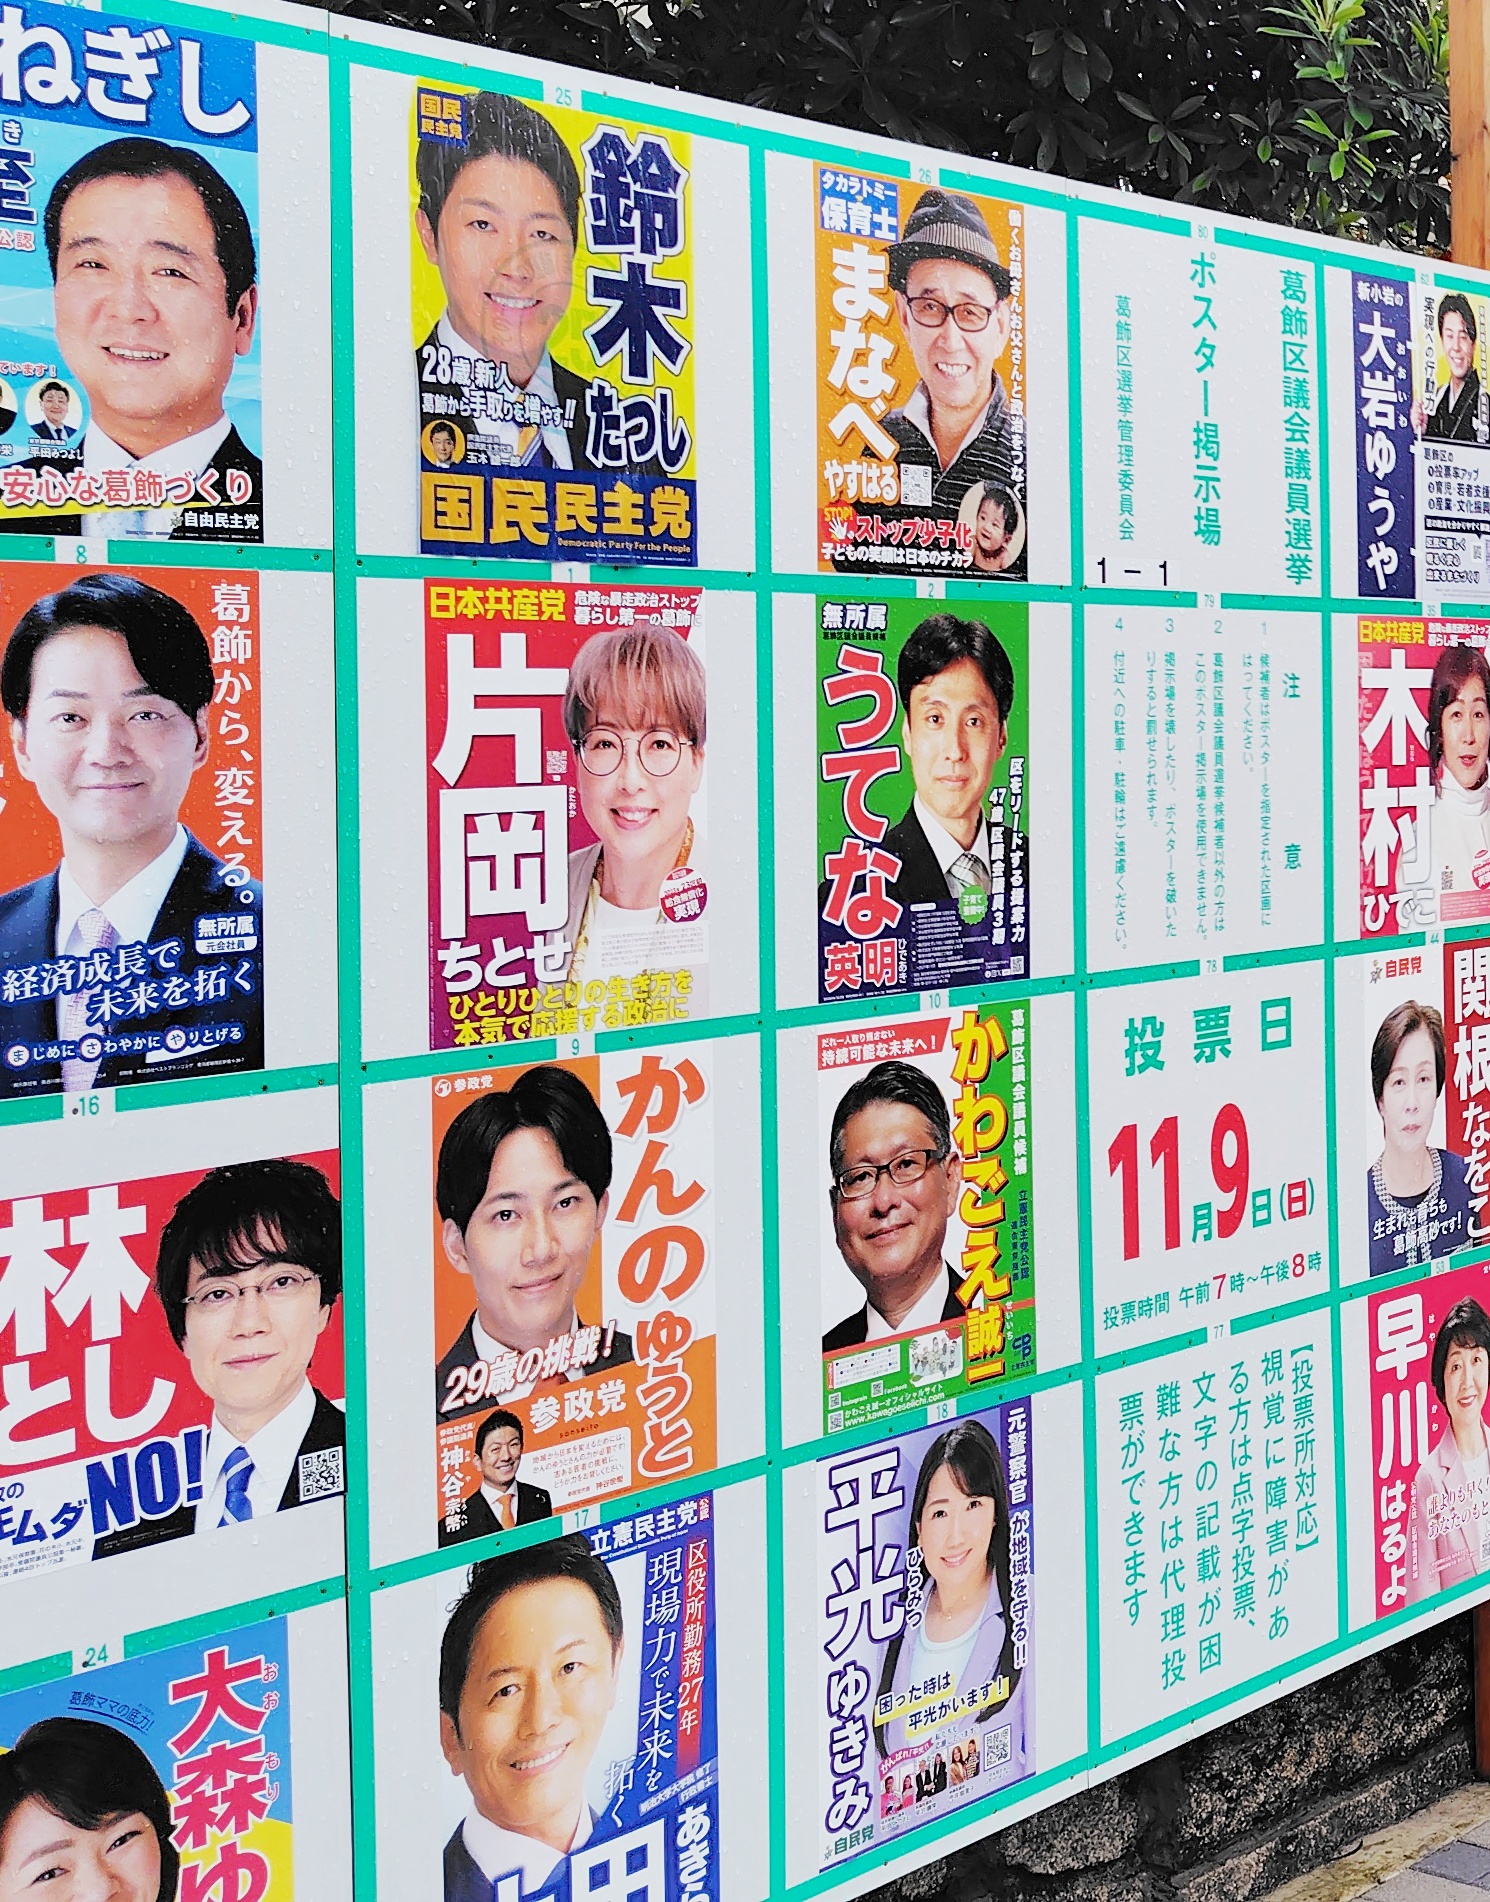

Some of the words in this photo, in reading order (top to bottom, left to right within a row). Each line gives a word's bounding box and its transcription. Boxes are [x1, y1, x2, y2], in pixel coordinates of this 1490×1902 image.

[0, 17, 252, 136] ねぎし
[555, 88, 571, 105] 25
[420, 93, 464, 121] 国民
[421, 120, 464, 141] 民主党
[822, 169, 896, 200] タカラトミー
[919, 168, 931, 183] 26
[821, 196, 898, 240] 保育士
[582, 124, 692, 386] 鈴木
[1357, 280, 1403, 308] 新小岩の
[828, 243, 898, 460] まなべ
[1115, 295, 1134, 541] 葛飾区選挙管理委員会
[1189, 251, 1221, 546] ポスター掲示場
[1280, 269, 1313, 585] 葛飾区議会議員選挙
[1359, 310, 1400, 591] 大岩ゆうや
[29, 446, 84, 460] 平田みつよし
[3, 466, 253, 507] 安心な葛飾づくり
[824, 458, 898, 503] やすはる
[183, 511, 259, 530] 自由民主党
[422, 472, 693, 545] 国民民主党
[855, 515, 973, 550] ストップ少子化
[75, 545, 87, 564] 8
[557, 537, 607, 551] Democratic
[608, 540, 634, 553] Party
[662, 543, 691, 555] People
[821, 542, 974, 568] 子どもの笑顔は日本のチカラ
[430, 586, 566, 621] 日本共産党
[928, 583, 935, 598] 2
[573, 606, 704, 628] 暮らし第一の葛飾に
[822, 602, 888, 631] 無所属
[1359, 620, 1425, 645] 日本共産党
[211, 583, 254, 905] 葛飾から、変える。
[1361, 648, 1437, 889] 木村
[433, 633, 570, 940] 片岡
[821, 645, 904, 938] うてな
[197, 917, 255, 938] 無所属
[1363, 889, 1437, 932] ひでこ
[206, 938, 246, 952] 元会社員
[438, 931, 573, 992] ちとせ
[824, 938, 899, 993] 英明
[1385, 956, 1422, 979] 自民党
[2, 941, 181, 1002] 経済成長で
[90, 968, 254, 1025] 未来を拓く
[448, 969, 693, 1019] ひとりひとりの生き方を
[454, 996, 689, 1047] 本気で応援する政治に
[929, 994, 940, 1008] 10
[572, 1038, 580, 1055] 9
[1124, 997, 1292, 1077] 投票日
[78, 1096, 100, 1117] 16
[454, 1075, 493, 1092] 参政党
[1010, 1009, 1028, 1175] 葛飾区議会議員候補
[950, 1010, 1010, 1384] かわごえ誠一
[615, 1054, 706, 1478] かんのゆうと
[1005, 1301, 1013, 1340] せいいち
[1103, 1291, 1170, 1331] 投票時間
[1213, 1325, 1225, 1341] 77
[440, 1319, 617, 1413] 29歳の挑戦!
[529, 1378, 627, 1433] 参政党
[936, 1403, 948, 1419] 18
[1006, 1406, 1028, 1505] 元警察官
[1375, 1293, 1429, 1607] 早川はるよ
[86, 1427, 204, 1536] NO!
[440, 1444, 466, 1533] 神谷宗幣
[1261, 1349, 1290, 1641] 視覚に障害があ
[575, 1510, 588, 1528] 17
[590, 1501, 698, 1556] 立憲民主党
[1118, 1391, 1148, 1627] 票ができます
[1192, 1371, 1221, 1675] 文字の記載が困
[1156, 1380, 1186, 1691] 難な方は代理投
[906, 1548, 923, 1629] ひらみつ
[85, 1646, 109, 1667] 24
[678, 1538, 708, 1735] 区役所勤務27年
[824, 1446, 906, 1835] 平光ゆきみ
[637, 1547, 682, 1791] 現場力で未来を
[878, 1673, 951, 1715] 困った時は
[69, 1690, 156, 1731] 葛飾ママの底力!
[263, 1664, 279, 1801] おおもり
[605, 1757, 634, 1828] 拓く
[834, 1823, 874, 1856] 自民党
